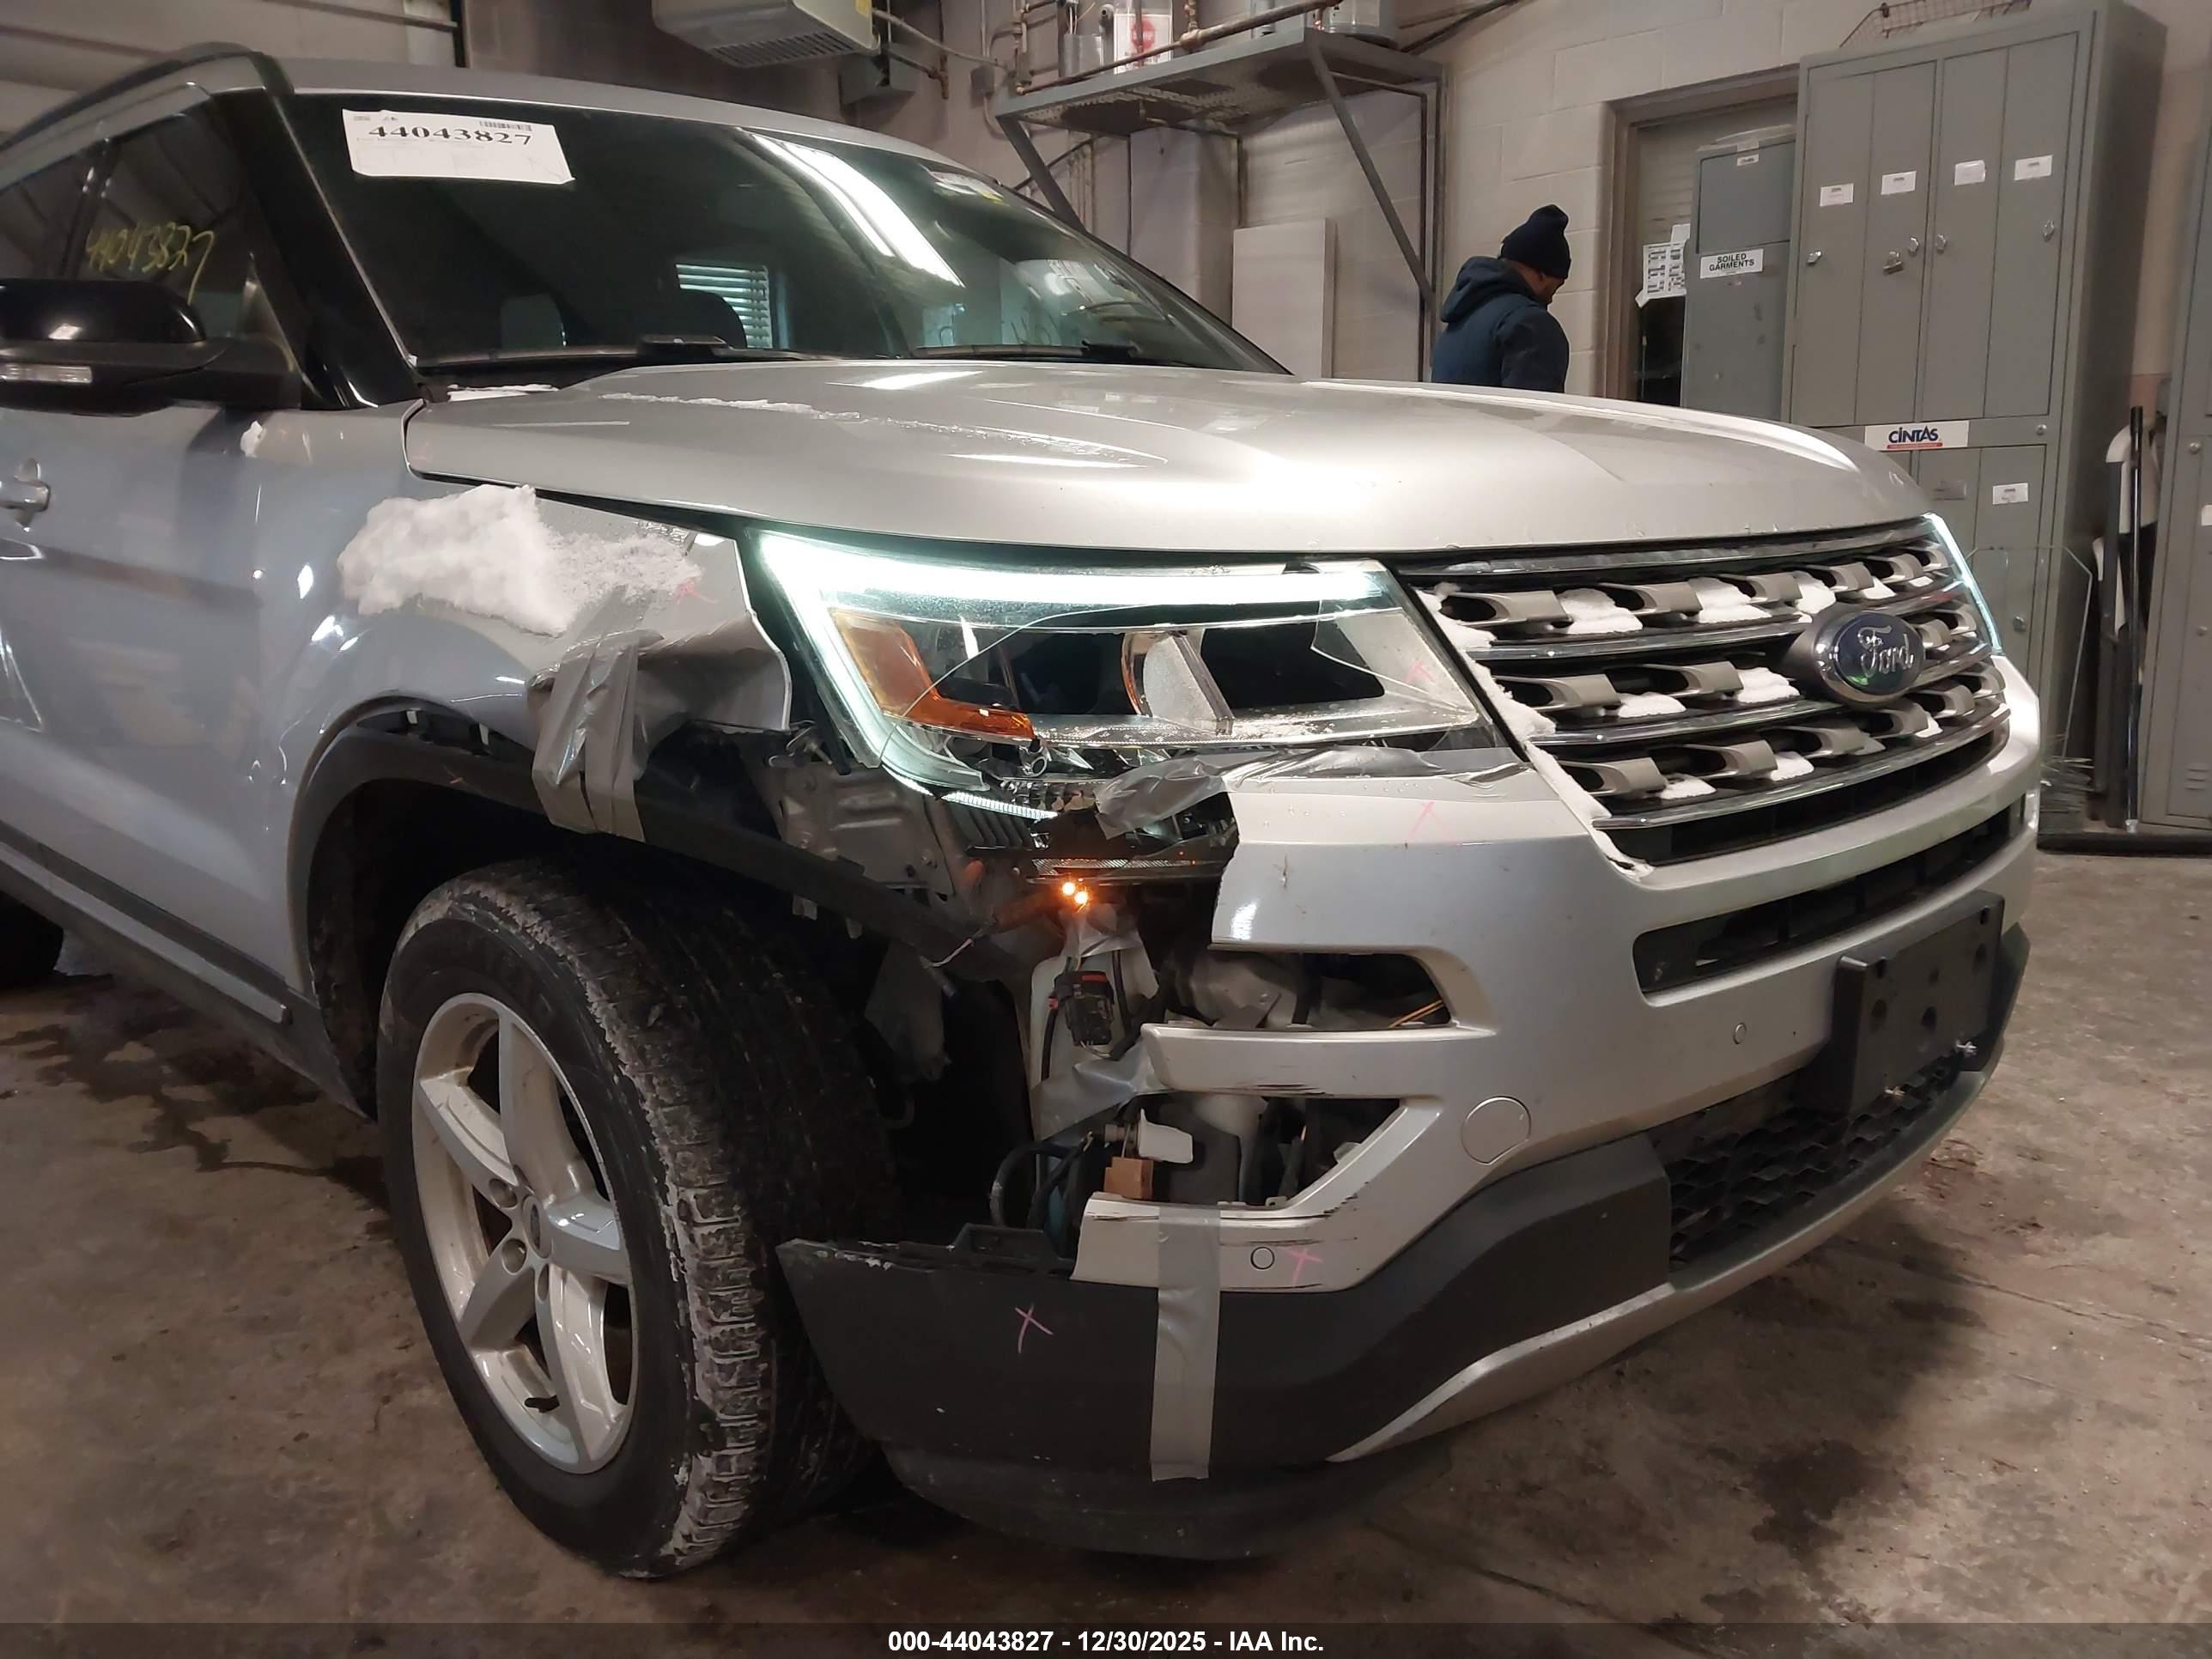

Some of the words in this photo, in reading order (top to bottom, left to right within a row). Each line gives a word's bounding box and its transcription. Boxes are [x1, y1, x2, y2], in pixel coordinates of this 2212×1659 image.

[368, 126, 532, 145] 44043827
[1709, 258, 1755, 271] GARMENTS
[1717, 253, 1747, 263] SOILED
[1888, 426, 1939, 443] CINTAS
[1857, 625, 1914, 678] Ford
